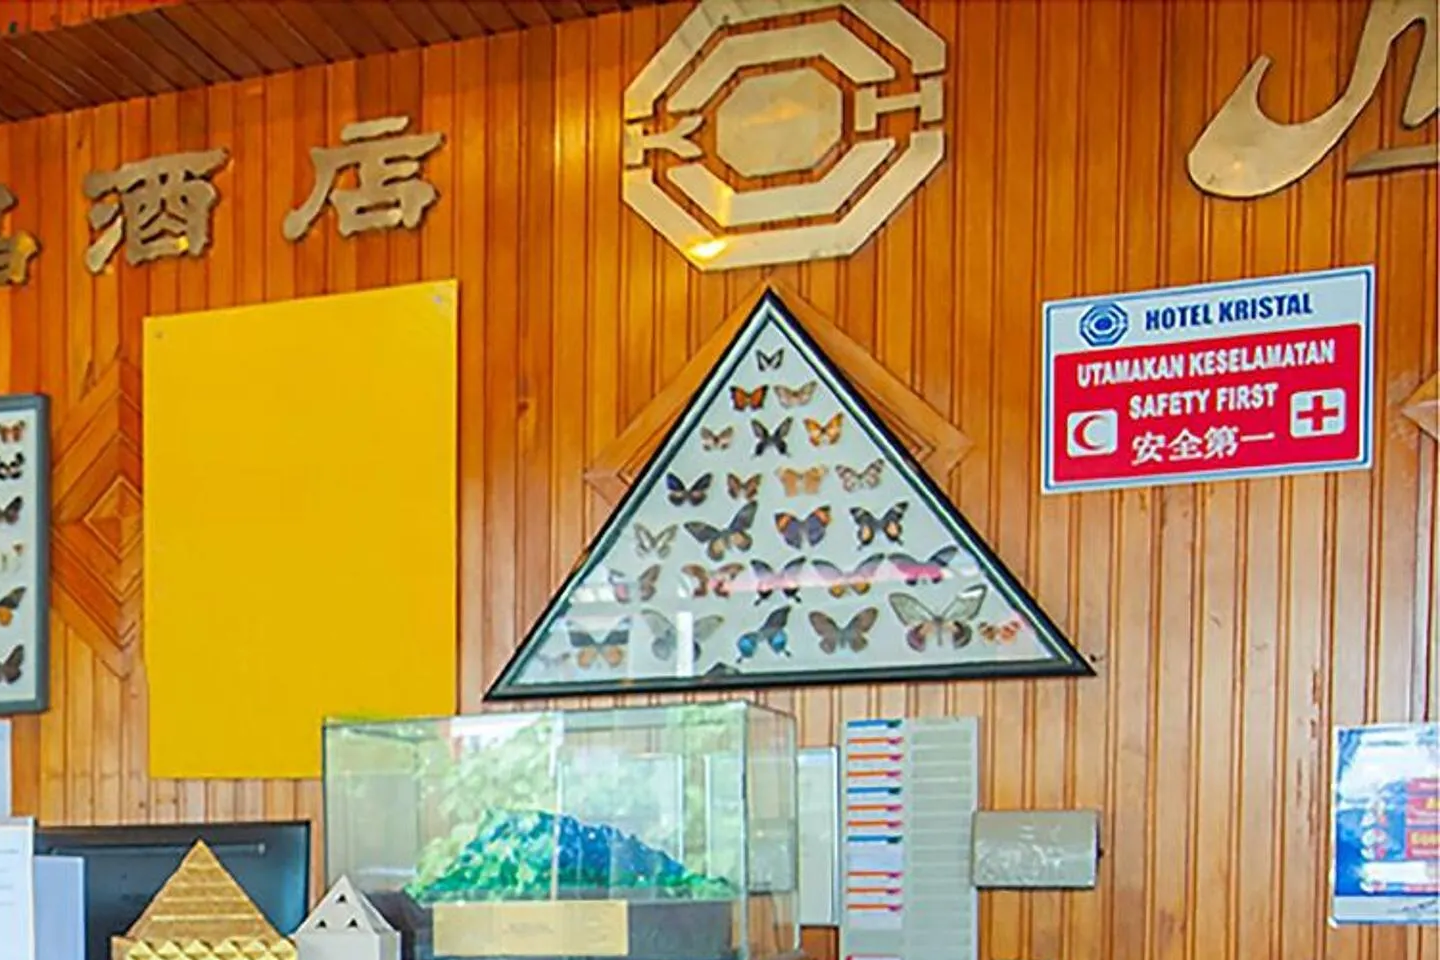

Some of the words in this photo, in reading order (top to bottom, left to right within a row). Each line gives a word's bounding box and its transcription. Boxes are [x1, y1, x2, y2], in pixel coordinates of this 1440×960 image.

[1145, 304, 1213, 331] HOTEL
[1218, 293, 1313, 323] KRISTAL
[1077, 354, 1185, 388] UTAMAKAN
[1189, 339, 1336, 377] KESELAMATAN
[1128, 389, 1210, 420] SAFETY
[1216, 383, 1280, 412] FIRST
[1130, 424, 1276, 465] 安全第一
